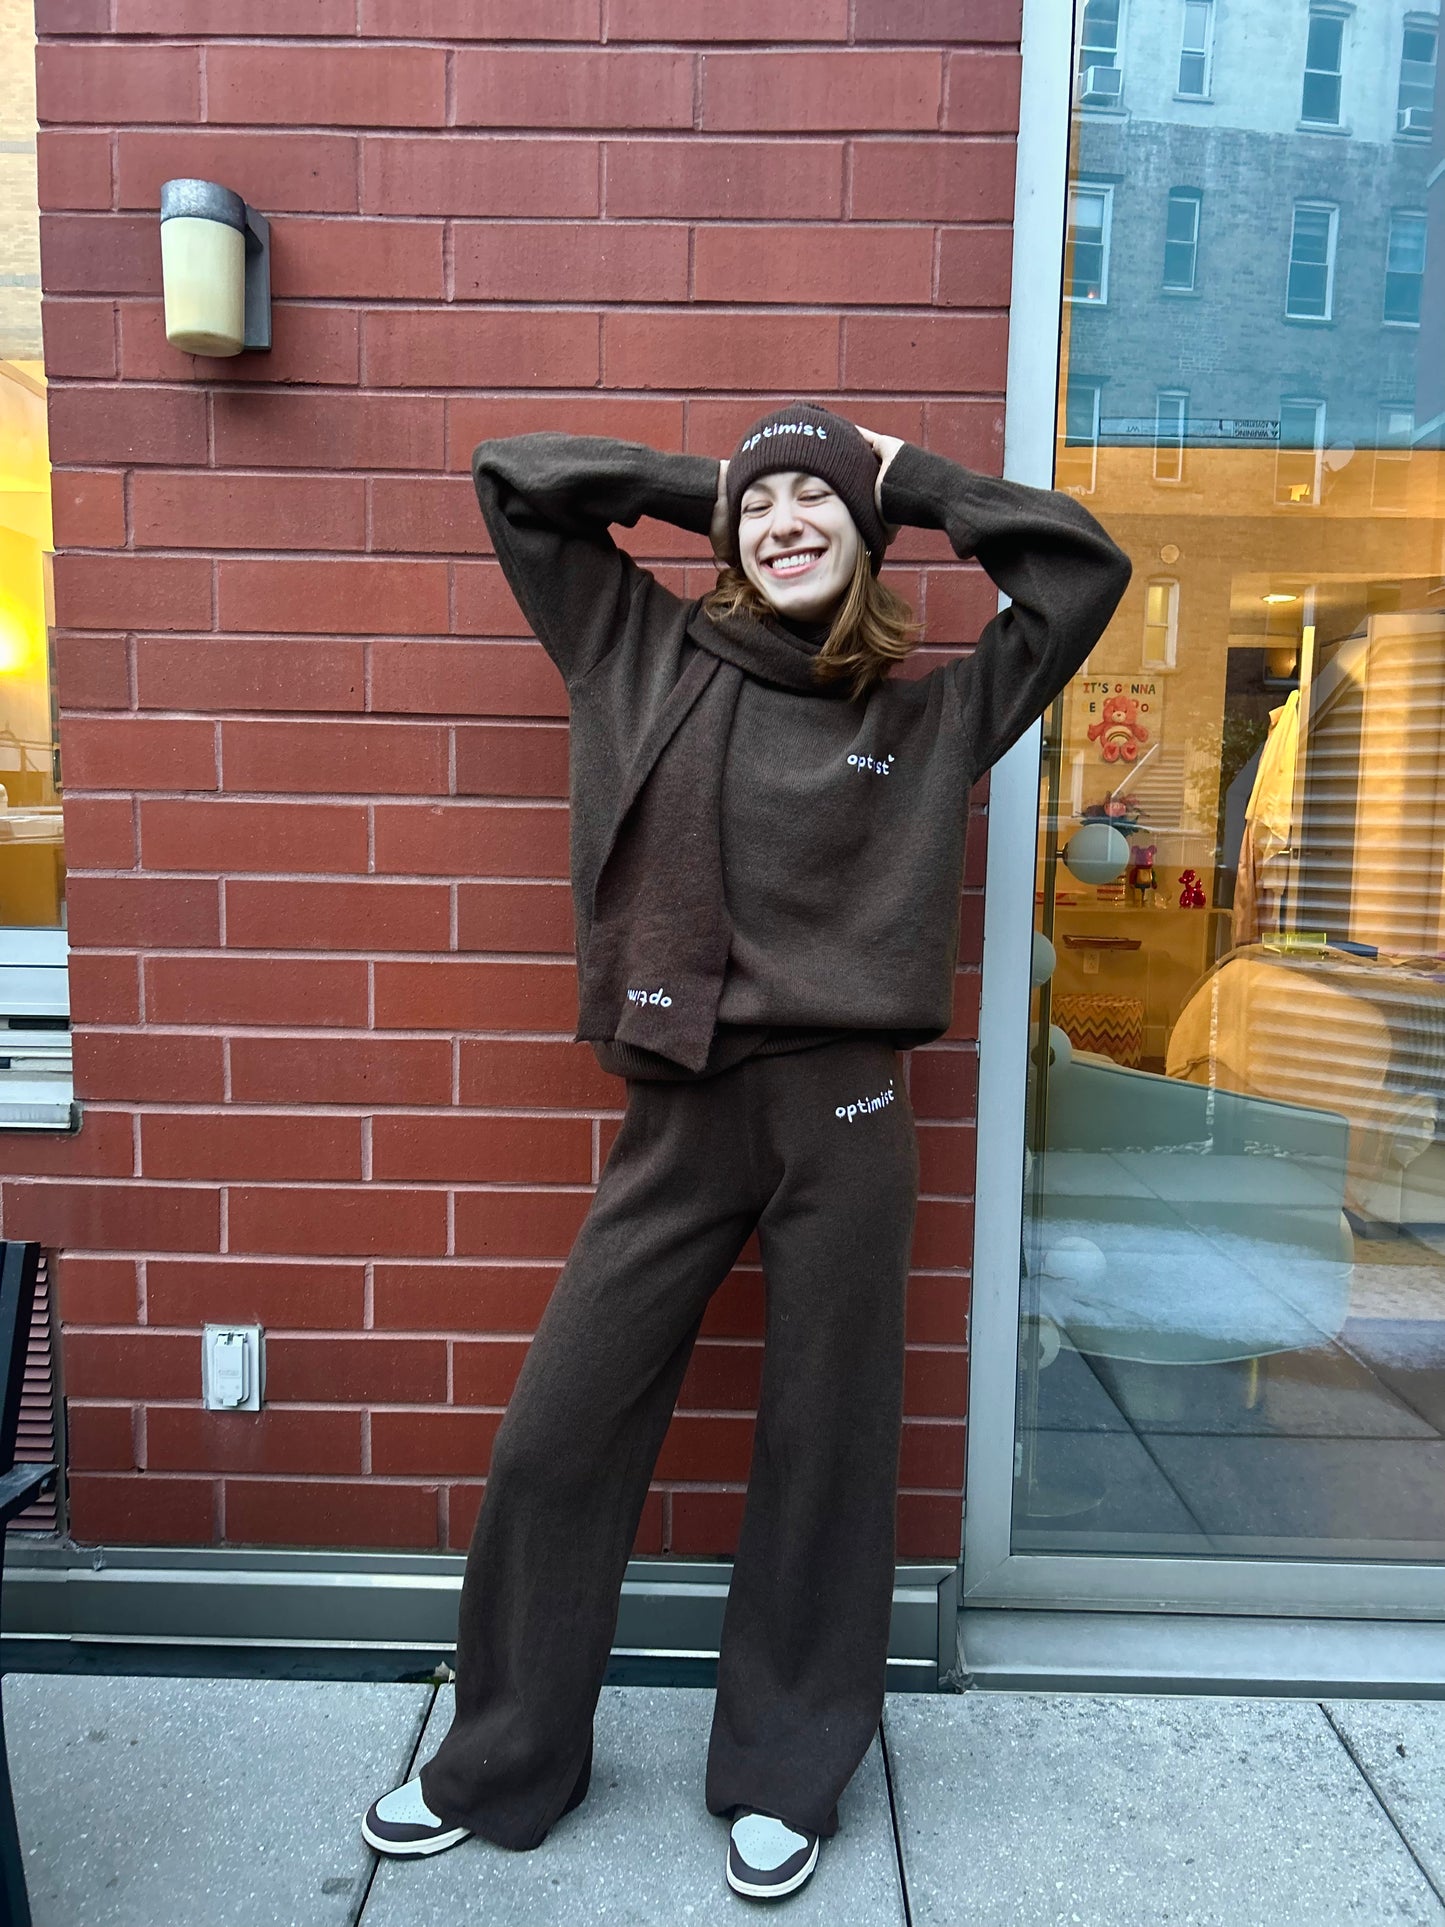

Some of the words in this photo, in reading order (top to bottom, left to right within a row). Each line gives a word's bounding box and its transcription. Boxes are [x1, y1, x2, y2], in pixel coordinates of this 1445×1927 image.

[742, 422, 827, 452] optimist
[1083, 682, 1109, 694] IT'S
[1115, 683, 1156, 694] GNNA
[835, 1088, 895, 1123] optimist
